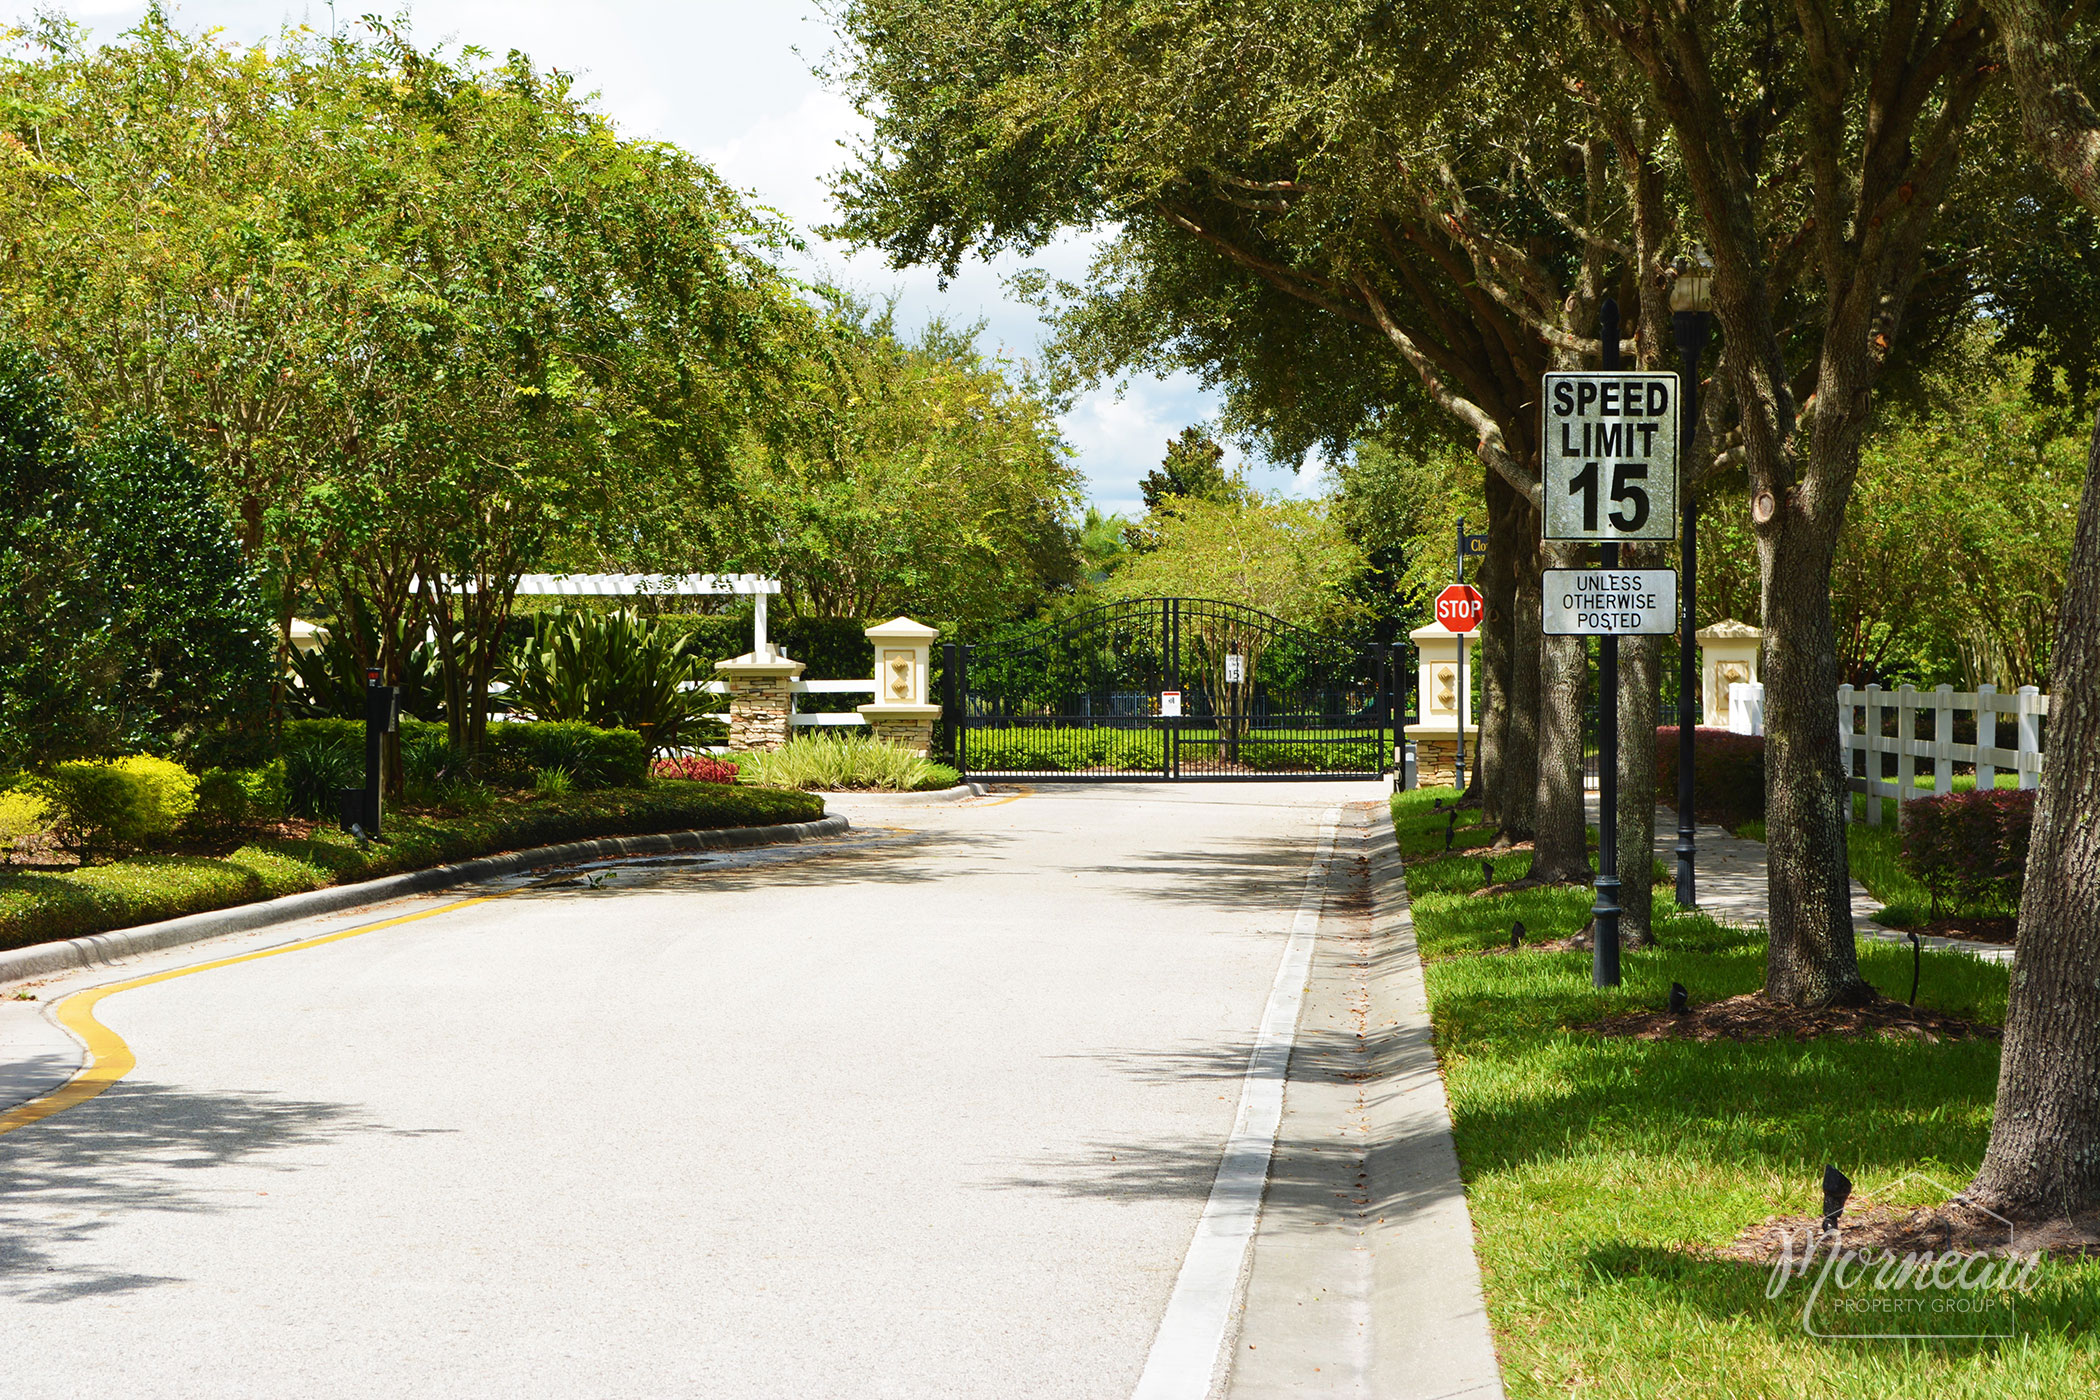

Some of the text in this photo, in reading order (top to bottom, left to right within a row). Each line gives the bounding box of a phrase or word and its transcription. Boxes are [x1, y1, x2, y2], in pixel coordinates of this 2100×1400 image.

[1553, 381, 1669, 417] SPEED
[1561, 422, 1659, 458] LIMIT
[1568, 462, 1650, 531] 15
[1471, 539, 1488, 552] Clo
[1577, 575, 1642, 591] UNLESS
[1439, 600, 1481, 618] STOP
[1562, 593, 1656, 609] OTHERWISE
[1577, 612, 1641, 628] POSTED
[1228, 669, 1239, 679] 15
